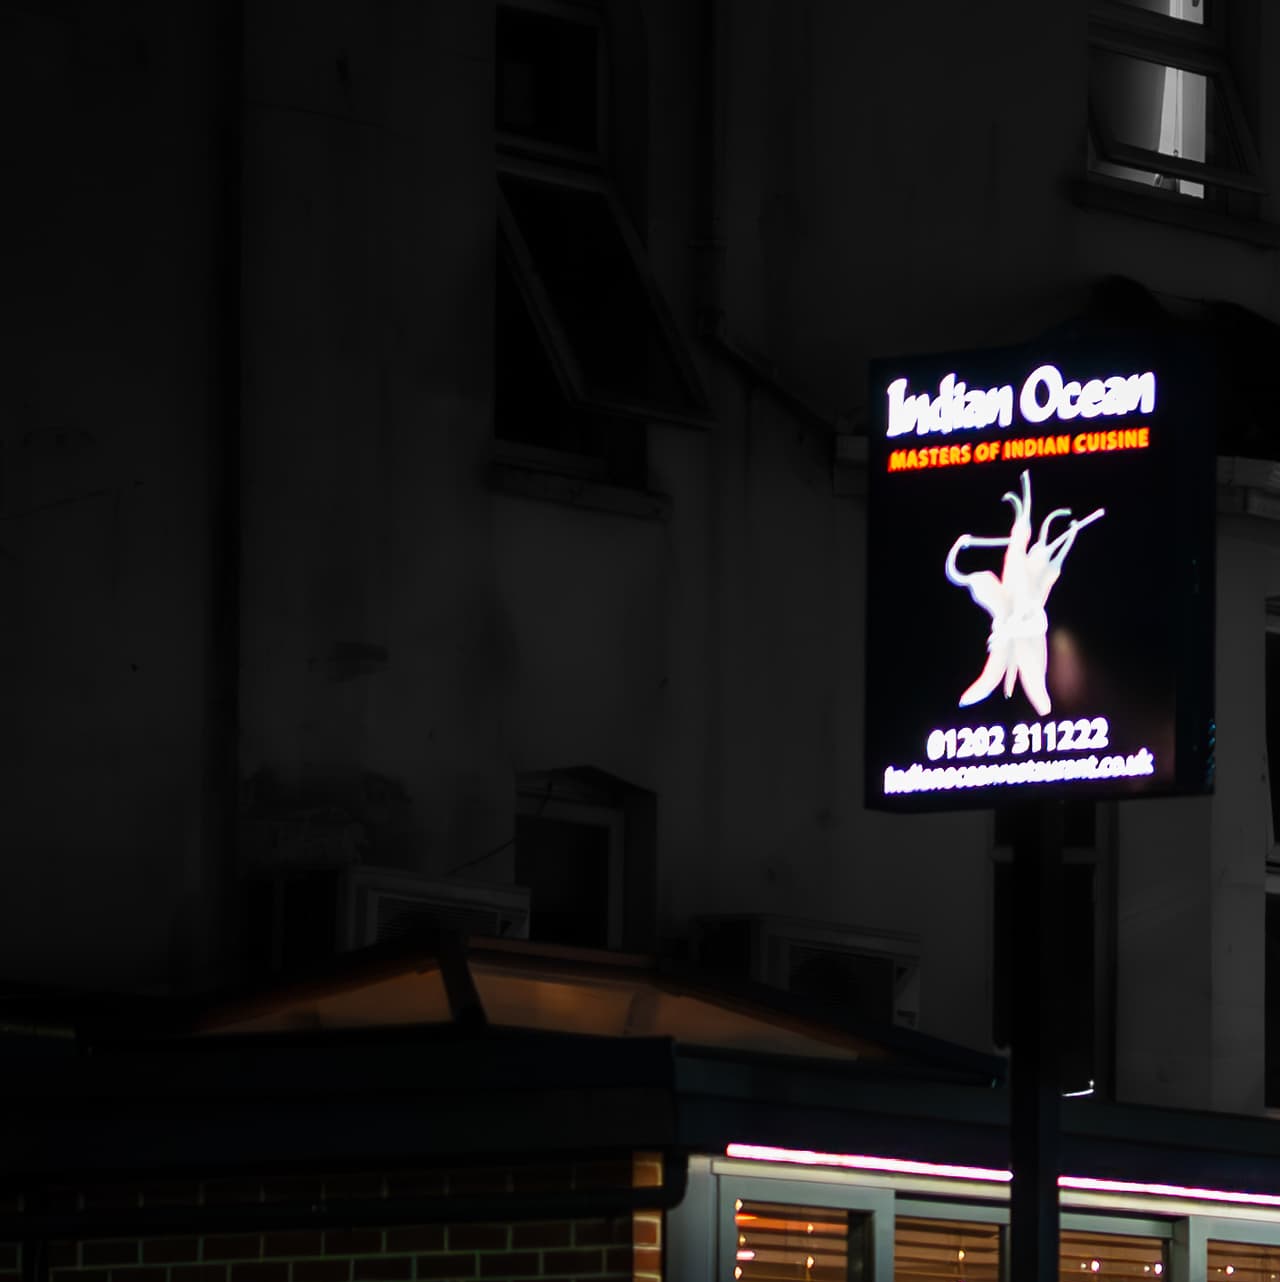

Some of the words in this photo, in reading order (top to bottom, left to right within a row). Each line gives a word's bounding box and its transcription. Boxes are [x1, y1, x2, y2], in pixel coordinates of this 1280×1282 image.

[886, 373, 1014, 438] Indian
[1019, 364, 1156, 423] Ocean
[888, 443, 972, 473] MASTERS
[973, 441, 1000, 462] OF
[1002, 434, 1070, 461] INDIAN
[1073, 427, 1151, 454] CUISINE
[926, 724, 1006, 761] 01202
[1011, 716, 1109, 755] 311222
